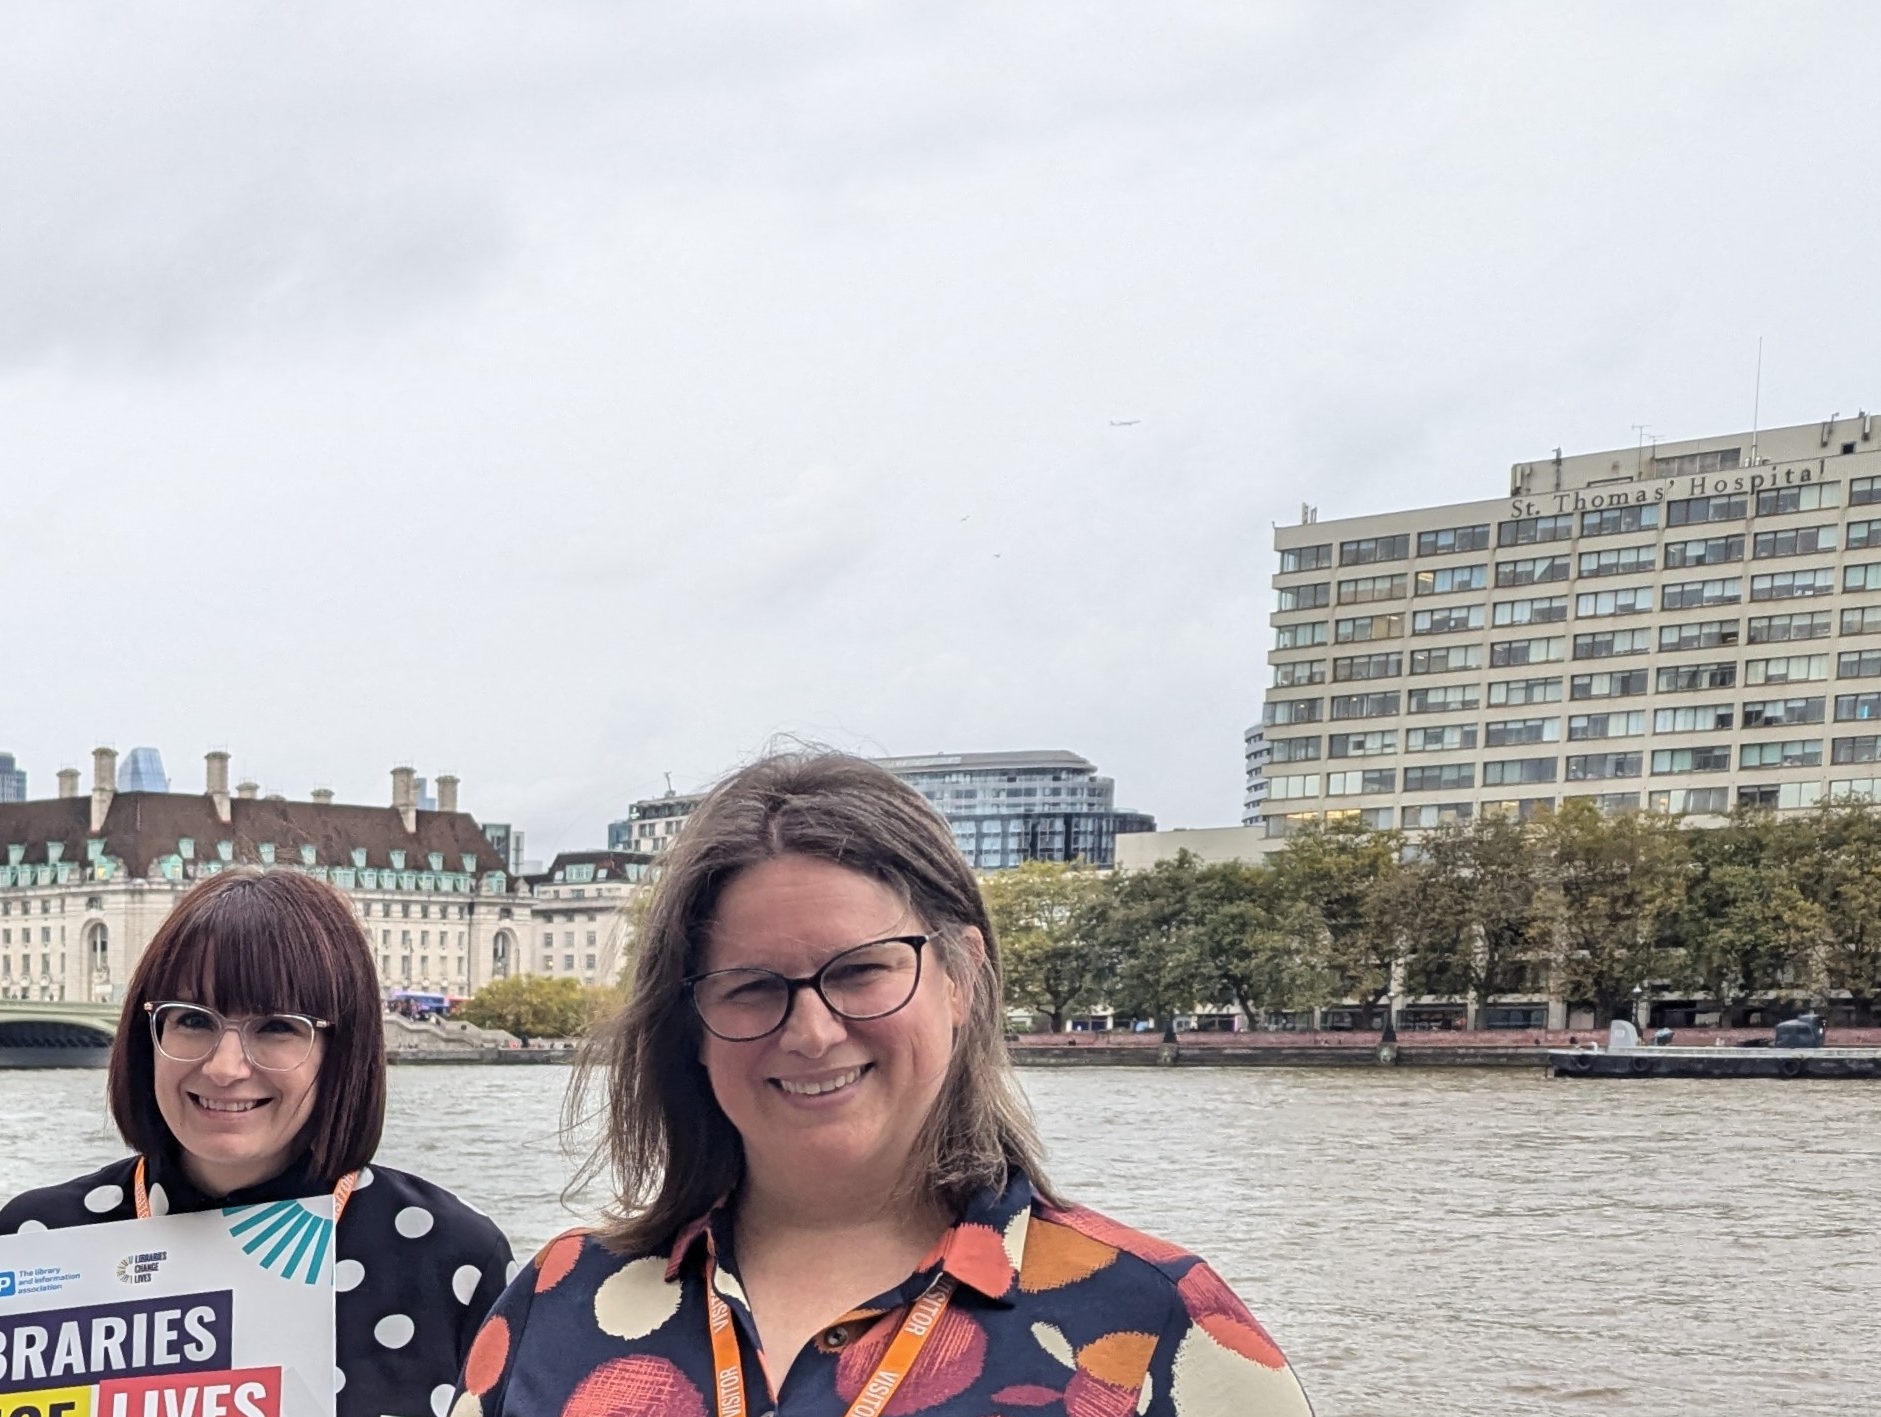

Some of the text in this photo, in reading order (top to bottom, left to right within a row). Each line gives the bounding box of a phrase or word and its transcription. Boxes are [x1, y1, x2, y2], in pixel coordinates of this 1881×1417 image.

[1510, 499, 1541, 520] St.
[1689, 459, 1826, 495] Hospital
[19, 1266, 61, 1278] The library
[134, 1262, 159, 1273] CHANGE
[18, 1273, 80, 1286] and information
[134, 1273, 151, 1284] LIVES
[18, 1284, 63, 1294] association
